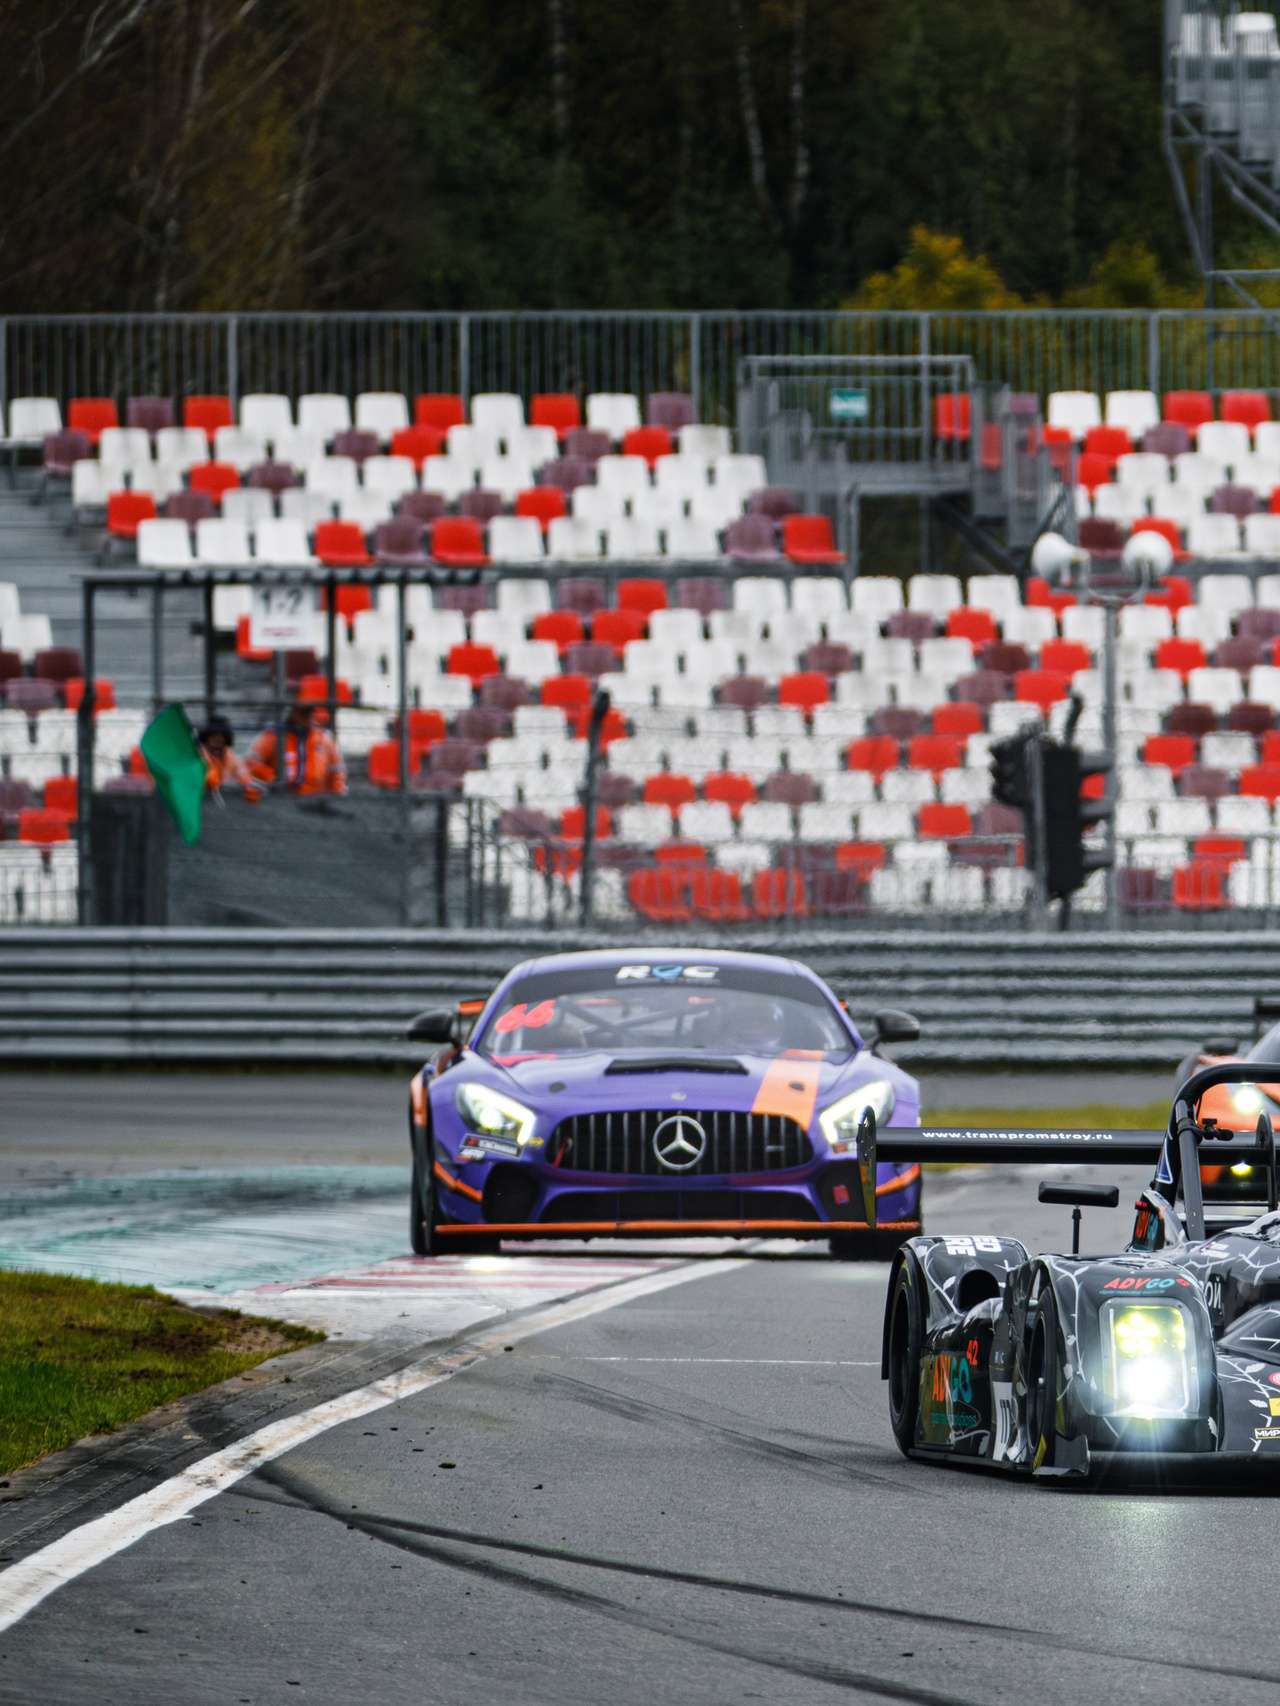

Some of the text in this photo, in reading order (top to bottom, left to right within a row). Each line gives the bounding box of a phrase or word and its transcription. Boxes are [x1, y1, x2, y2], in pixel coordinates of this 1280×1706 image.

[495, 1000, 556, 1033] 66
[922, 1131, 1113, 1142] www.transpromstroy.ru
[966, 1340, 979, 1366] 42
